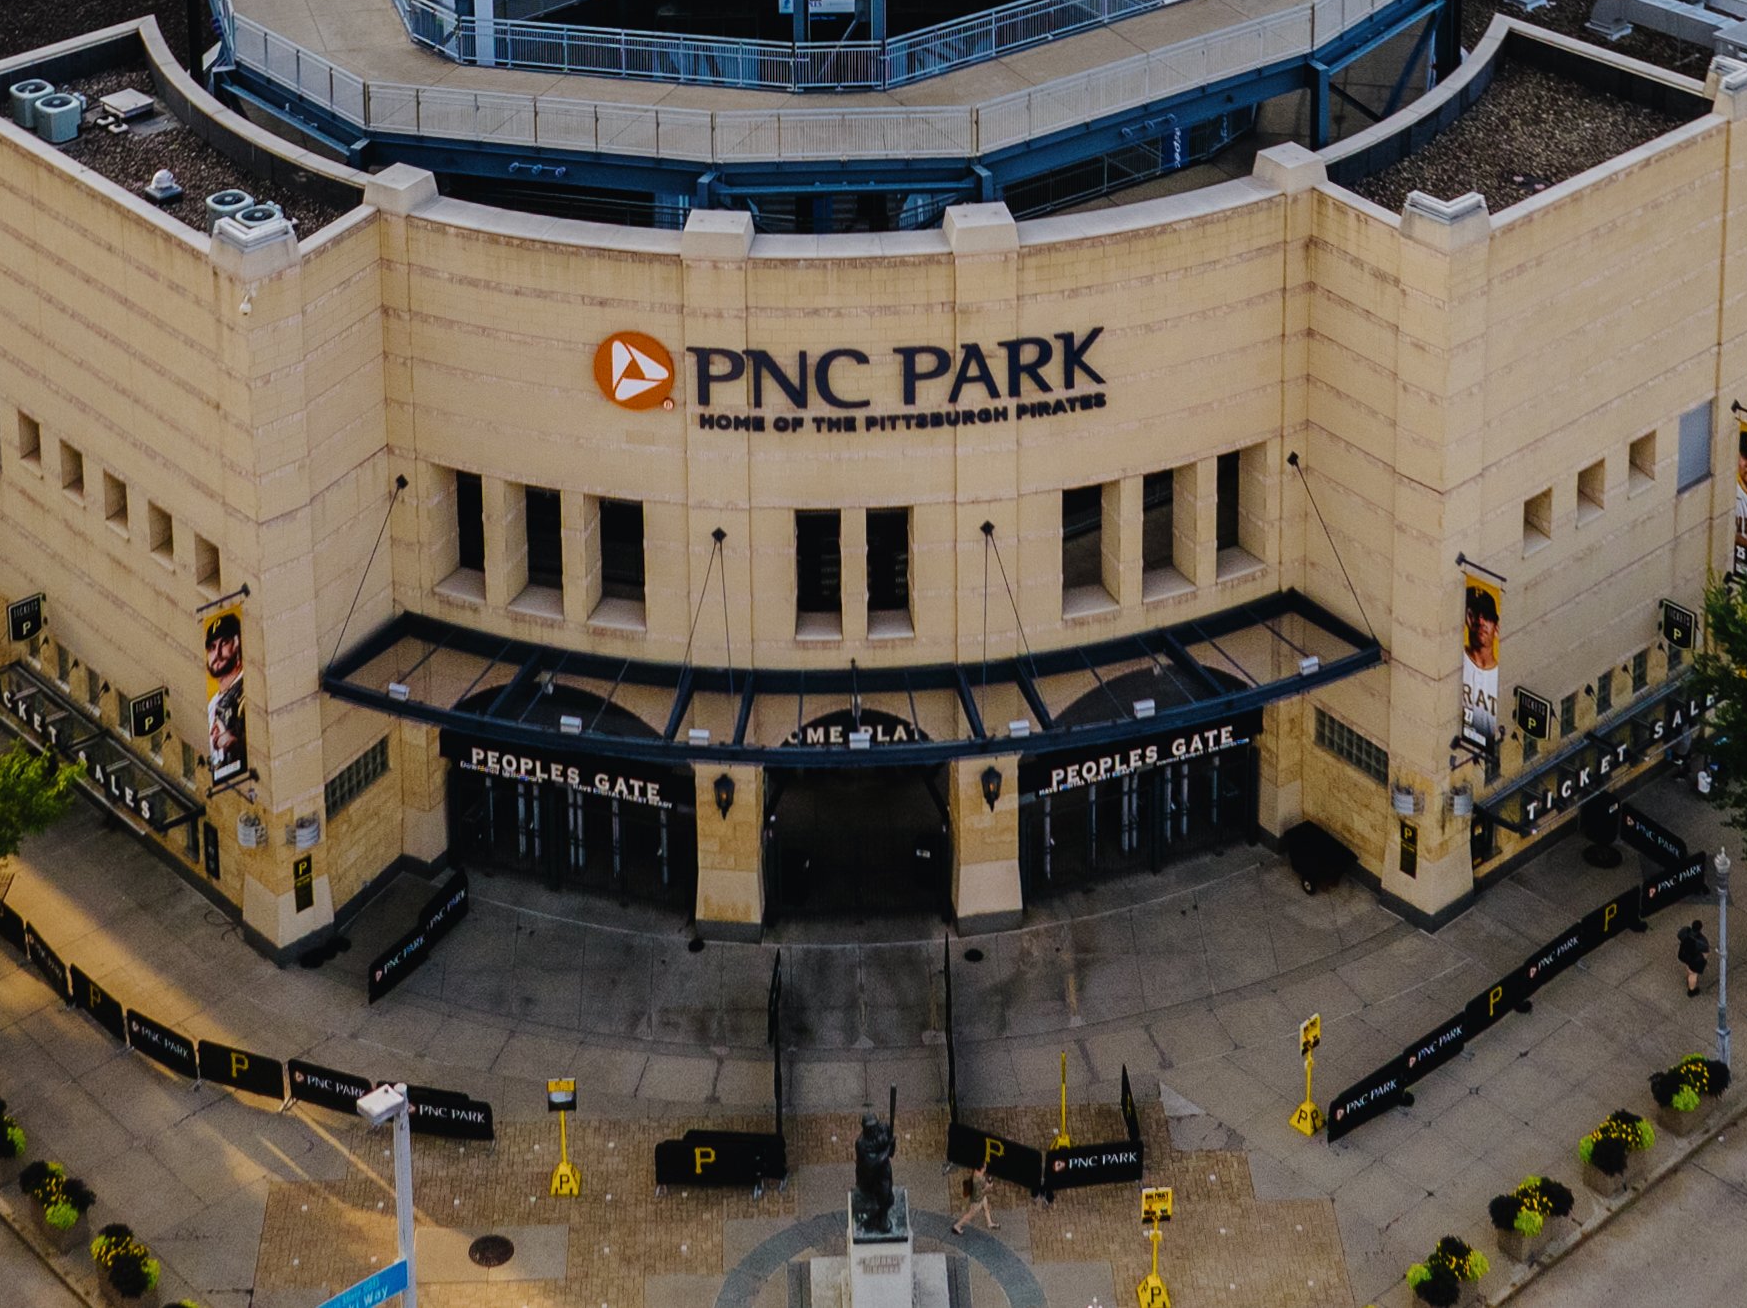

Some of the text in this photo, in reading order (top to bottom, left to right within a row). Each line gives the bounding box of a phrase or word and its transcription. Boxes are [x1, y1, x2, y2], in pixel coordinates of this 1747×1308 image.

[686, 327, 1105, 409] PNC PARK
[699, 391, 1106, 432] HOME OF THE PITTSBURGH PIRATES
[12, 601, 39, 619] TICKETS
[22, 621, 31, 635] P
[1673, 628, 1682, 640] P
[1520, 693, 1546, 717] TICKETS
[144, 716, 153, 731] P
[1527, 716, 1536, 730] P
[1051, 745, 1158, 788] PEOPLES
[1171, 725, 1234, 756] GATE
[1527, 690, 1717, 821] TICKET SALE
[471, 747, 580, 785] PEOPLES
[594, 772, 660, 802] GATE
[1404, 826, 1413, 839] P
[299, 861, 308, 875] P
[1657, 864, 1703, 893] PNC PARK
[1604, 903, 1617, 931] P
[384, 935, 425, 974] PNC PARK
[1537, 936, 1579, 970] PNC PARK
[90, 983, 101, 1005] P
[1489, 986, 1503, 1016] P
[140, 1024, 190, 1059] PNC PARK
[1417, 1025, 1462, 1062] PNC PARK
[230, 1051, 250, 1077] P
[307, 1075, 366, 1098] PNC PARK
[1346, 1079, 1397, 1114] PNC PARK
[419, 1103, 486, 1124] PNC PARK
[1297, 1108, 1308, 1124] P
[694, 1146, 716, 1174] P
[985, 1136, 1005, 1164] P
[1068, 1148, 1138, 1170] PNC PARK
[559, 1173, 570, 1189] P
[364, 1284, 389, 1307] Way
[1150, 1285, 1162, 1304] P
